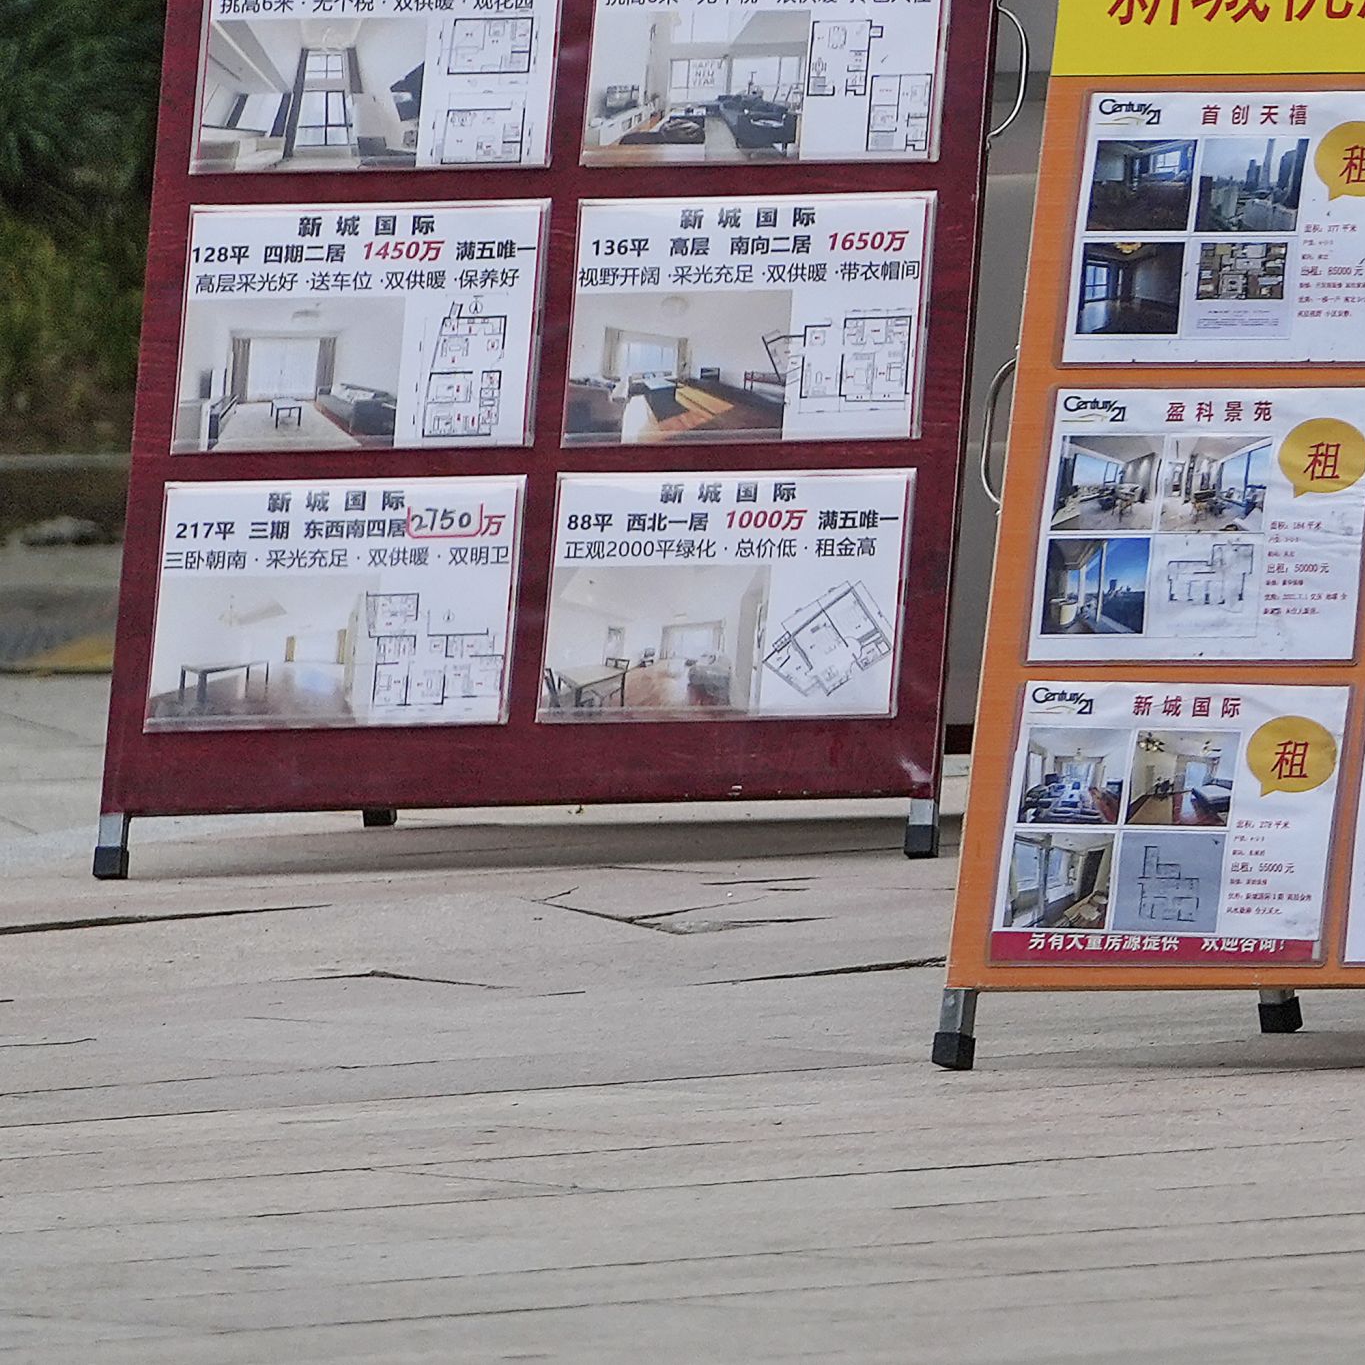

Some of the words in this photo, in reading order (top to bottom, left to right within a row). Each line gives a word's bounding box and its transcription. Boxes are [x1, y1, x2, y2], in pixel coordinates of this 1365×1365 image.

[1099, 99, 1152, 116] Century
[1145, 110, 1160, 125] 21
[1201, 105, 1308, 125] 首创天禧
[299, 215, 434, 237] 新城国际
[680, 207, 815, 229] 新城国际
[192, 245, 249, 263] 128平
[264, 245, 346, 263] 四期二居
[363, 240, 444, 261] 1450万
[456, 241, 536, 261] 满五唯一
[592, 238, 649, 256] 136平
[669, 236, 710, 256] 高层
[730, 235, 811, 255] 南向二居
[828, 230, 909, 252] 1650万
[196, 273, 299, 294] 高层采光好
[1166, 401, 1273, 422] 盈科景苑
[1303, 441, 1341, 481] 租
[268, 491, 404, 513] 新城国际
[660, 483, 796, 503] 新城国际
[176, 522, 235, 540] 217平
[249, 521, 289, 540] 三期
[304, 520, 406, 539] 东西南四居
[568, 513, 612, 533] 88平
[627, 513, 708, 532] 西北一居
[726, 510, 807, 530] 1000万
[818, 510, 898, 531] 满五唯一
[1133, 695, 1241, 718] 新城国际
[1271, 740, 1309, 780] 租
